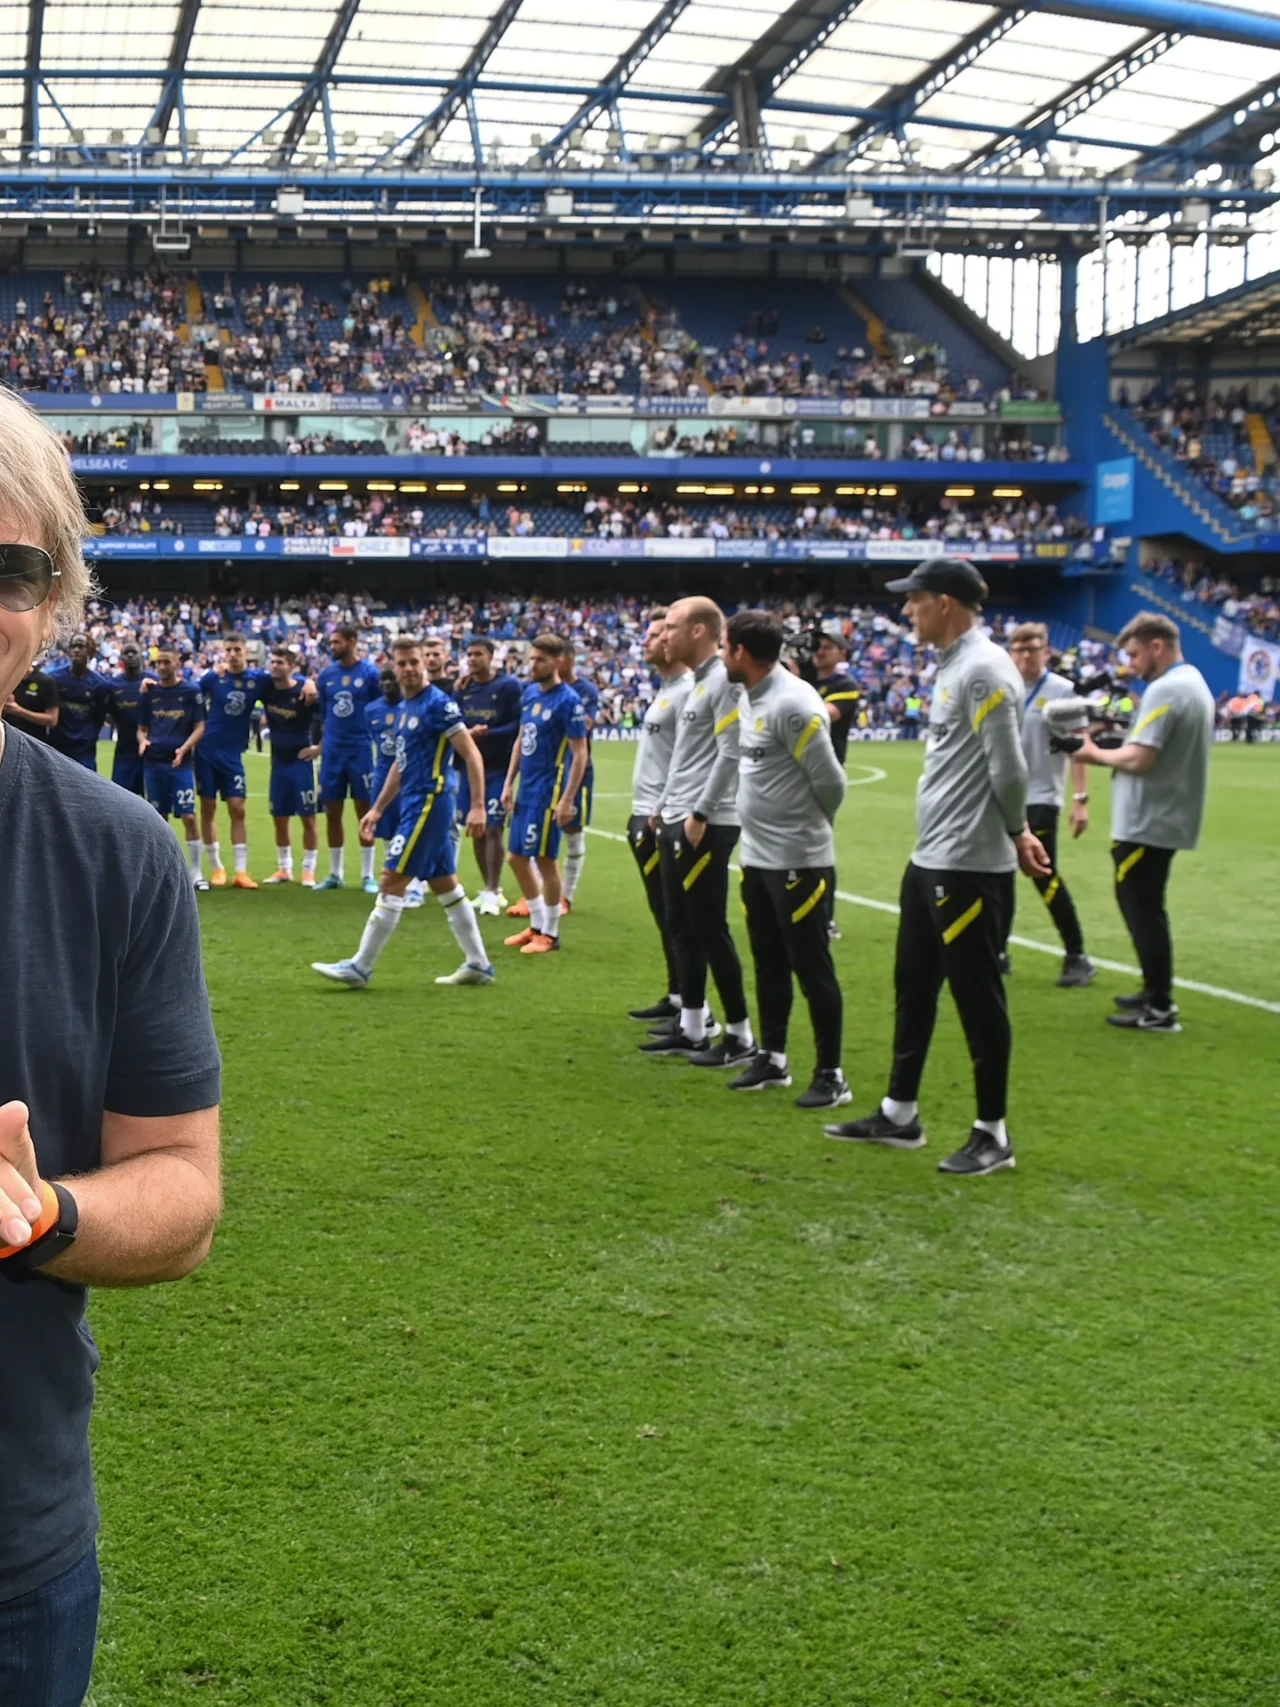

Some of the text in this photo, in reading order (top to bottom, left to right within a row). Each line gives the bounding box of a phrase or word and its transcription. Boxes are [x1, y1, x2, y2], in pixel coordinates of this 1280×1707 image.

[275, 400, 317, 408] MALTA
[70, 459, 128, 471] HELSEA FC
[176, 789, 195, 805] 22
[300, 790, 315, 804] 10
[487, 798, 506, 815] 2
[525, 824, 537, 843] 5
